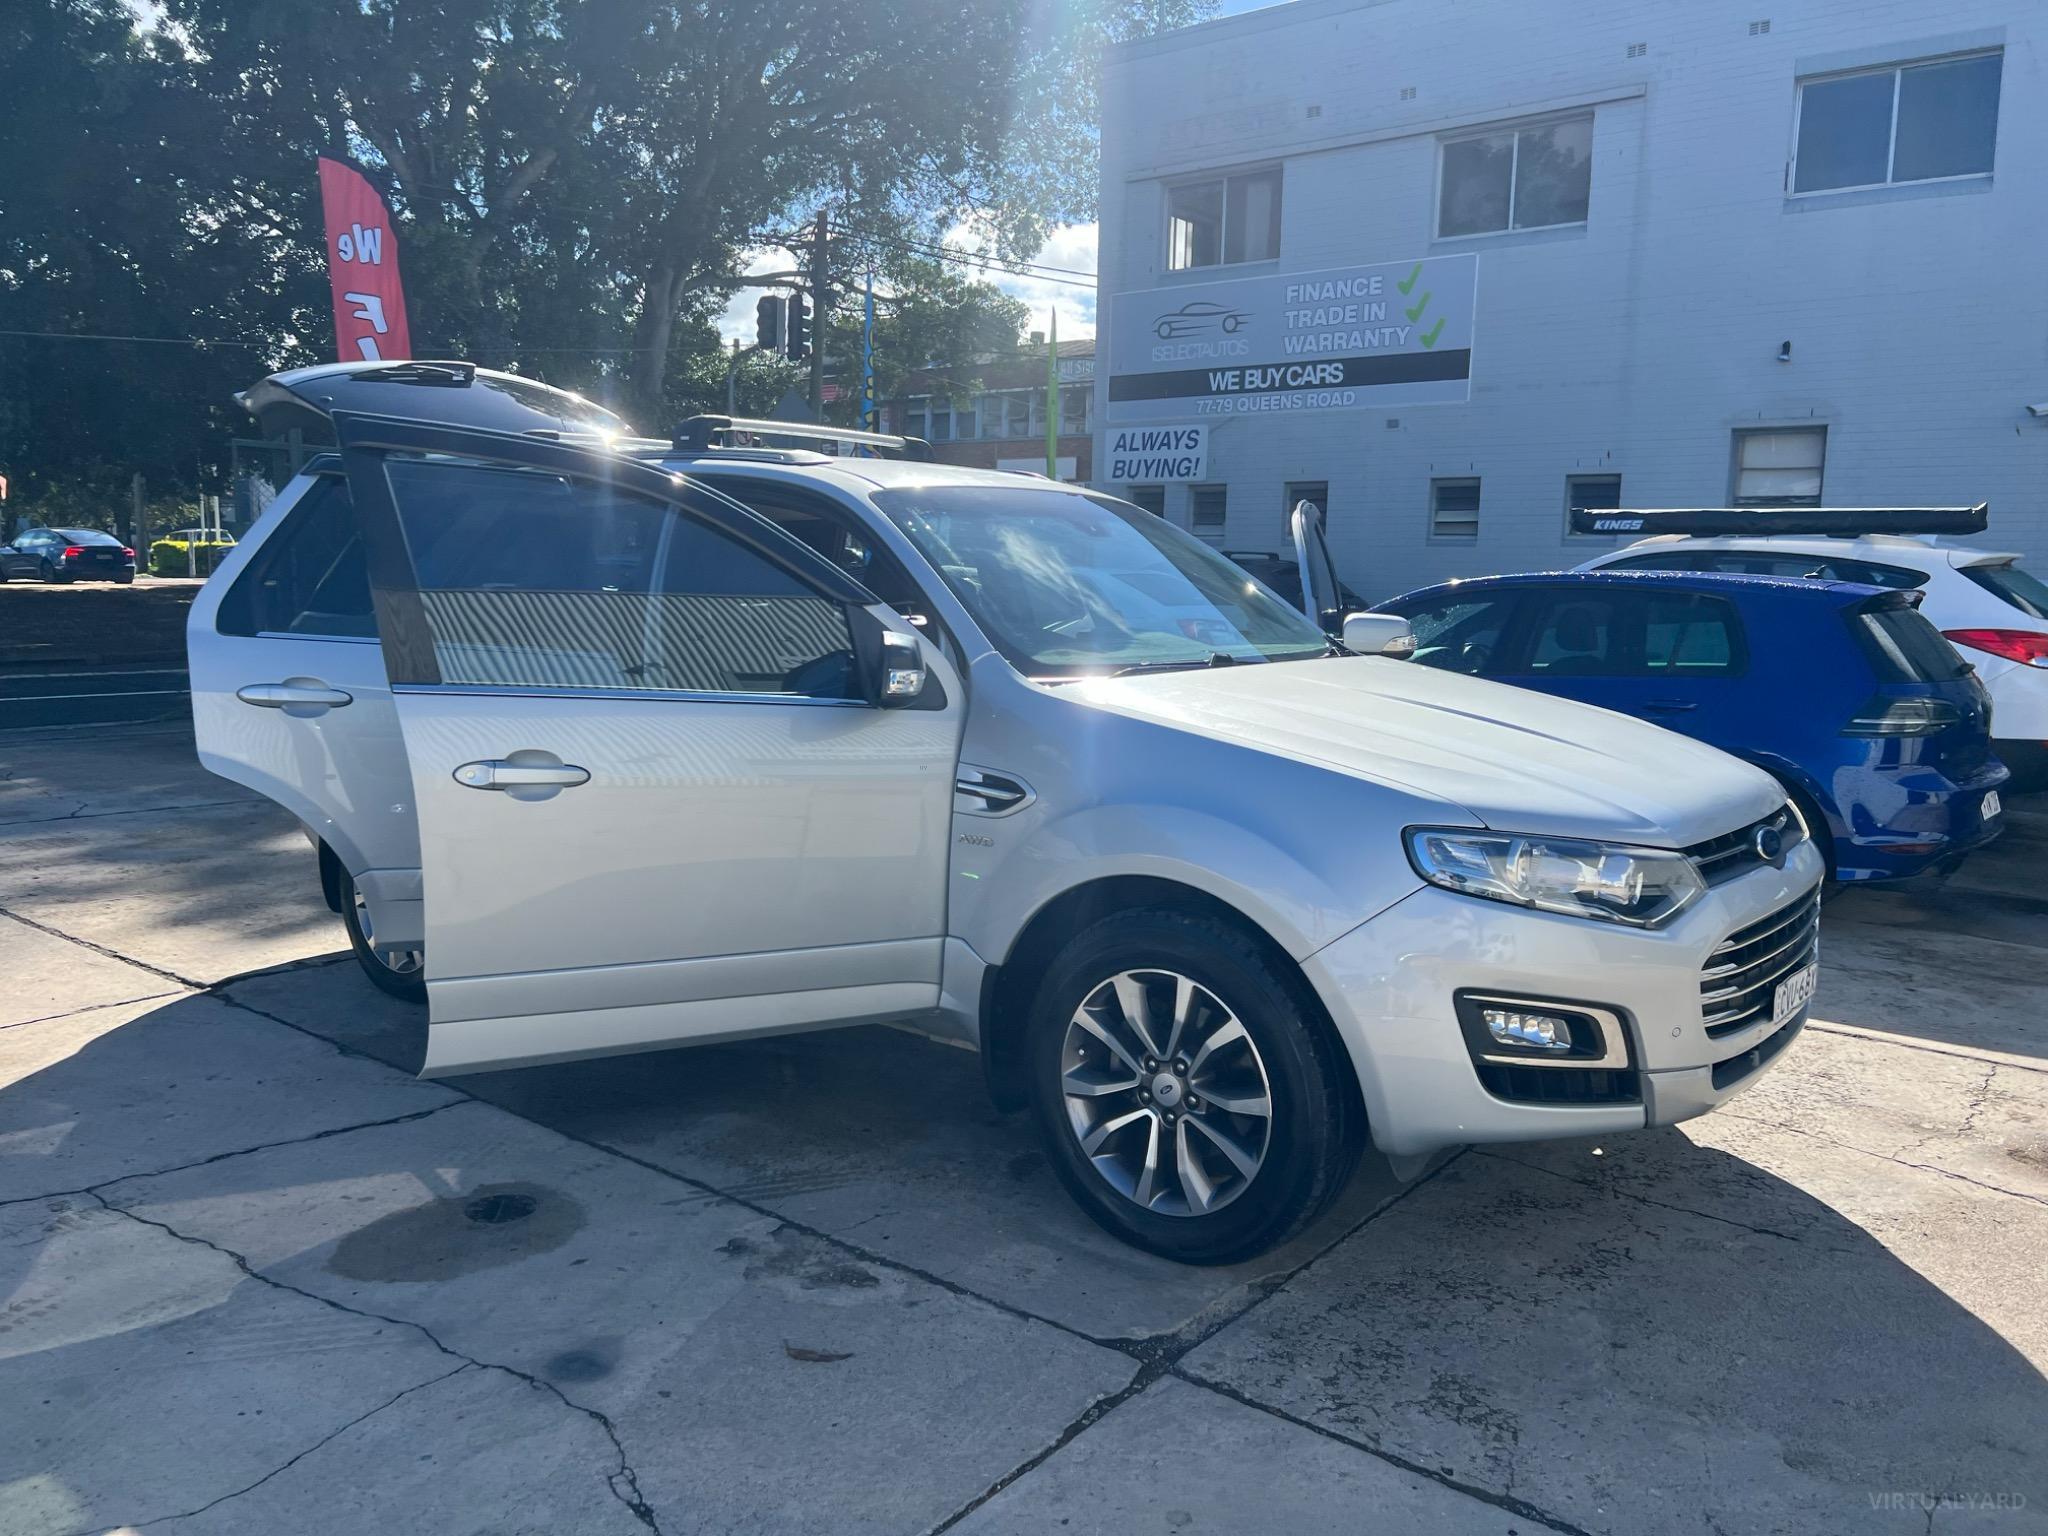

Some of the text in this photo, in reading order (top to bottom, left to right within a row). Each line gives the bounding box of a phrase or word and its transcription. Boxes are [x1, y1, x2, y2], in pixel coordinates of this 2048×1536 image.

[1285, 275, 1384, 304] FINANCE
[1283, 301, 1387, 329] TRADE IN
[1283, 325, 1412, 354] WARRANTY
[1208, 362, 1344, 392] WE BUY CARS
[1196, 390, 1356, 413] 77-79 QUEENS ROAD
[1112, 429, 1201, 452] ALWAYS
[1112, 457, 1201, 479] BUYING!
[1593, 519, 1645, 531] KINGS
